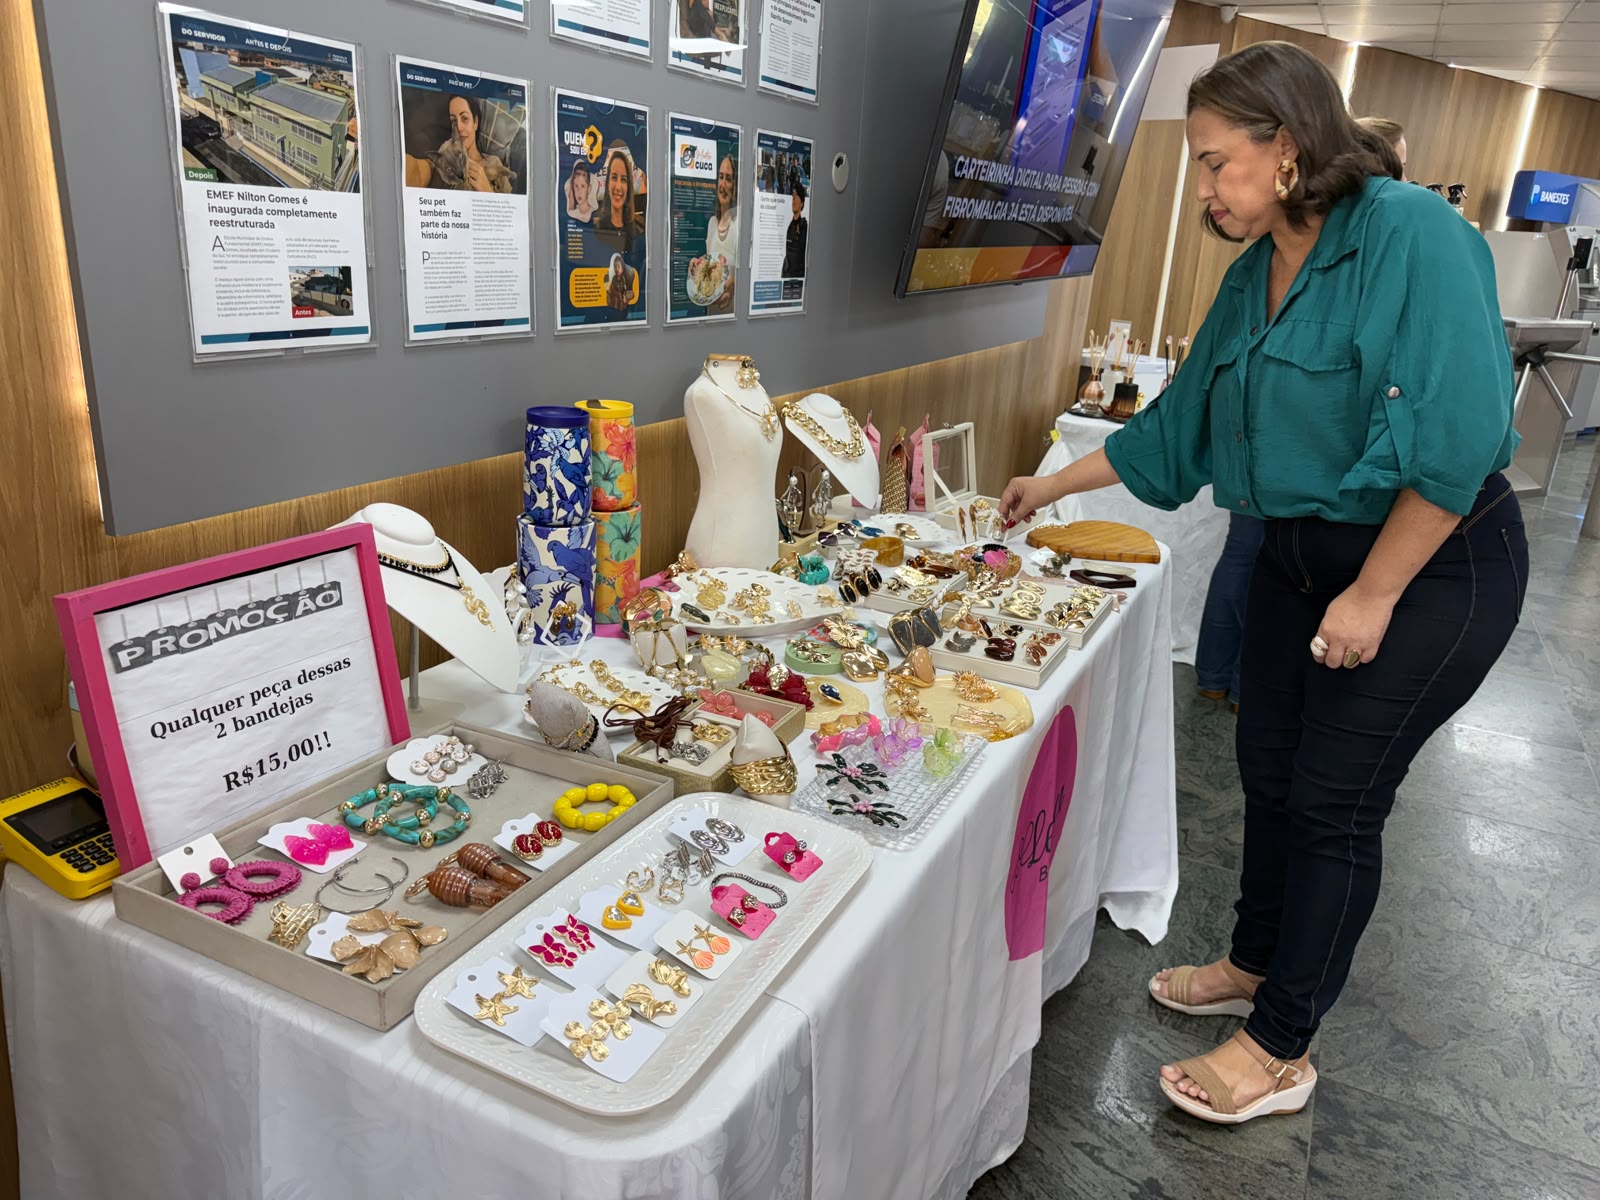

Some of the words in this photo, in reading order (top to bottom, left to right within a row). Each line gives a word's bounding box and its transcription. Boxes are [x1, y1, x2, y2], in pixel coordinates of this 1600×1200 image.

[181, 27, 193, 36] DO
[193, 29, 226, 43] SERVIDOR
[245, 38, 264, 49] ANTES
[269, 42, 293, 53] DEPOIS
[414, 74, 437, 84] SERVIDOR
[564, 130, 587, 146] QUEM
[695, 161, 713, 171] cuca
[188, 170, 214, 180] Depois
[954, 155, 1015, 185] CARTEIRINHA
[1014, 167, 1043, 189] DIGITAL
[1043, 174, 1062, 192] PARA
[1061, 176, 1088, 196] PESSOAS
[1086, 182, 1100, 198] COM
[206, 189, 235, 201] EMEF
[237, 190, 266, 203] Nilton
[268, 193, 300, 205] Gomes
[302, 195, 308, 205] é
[418, 197, 433, 206] Seu
[433, 198, 446, 208] pet
[1540, 190, 1570, 205] BANESTES
[207, 203, 264, 218] inaugurada
[265, 207, 338, 219] completamente
[419, 208, 450, 218] também
[451, 209, 462, 218] faz
[942, 196, 1008, 220] FIBROMIALGIA
[1007, 198, 1021, 222] JÁ
[1018, 200, 1040, 223] ESTÁ
[1036, 202, 1075, 224] DISPONÍVEL
[209, 218, 276, 229] reestruturada
[420, 220, 440, 231] parte
[440, 220, 450, 229] da
[451, 221, 470, 230] nossa
[421, 230, 448, 240] história
[294, 308, 312, 317] Antes
[116, 588, 341, 669] PROMOÇÃO
[150, 694, 245, 740] Qualquer
[249, 676, 293, 707] peça
[296, 655, 352, 687] dessas
[213, 722, 229, 740] 2
[233, 690, 314, 734] bandejas
[222, 730, 333, 793] R$15,00!!
